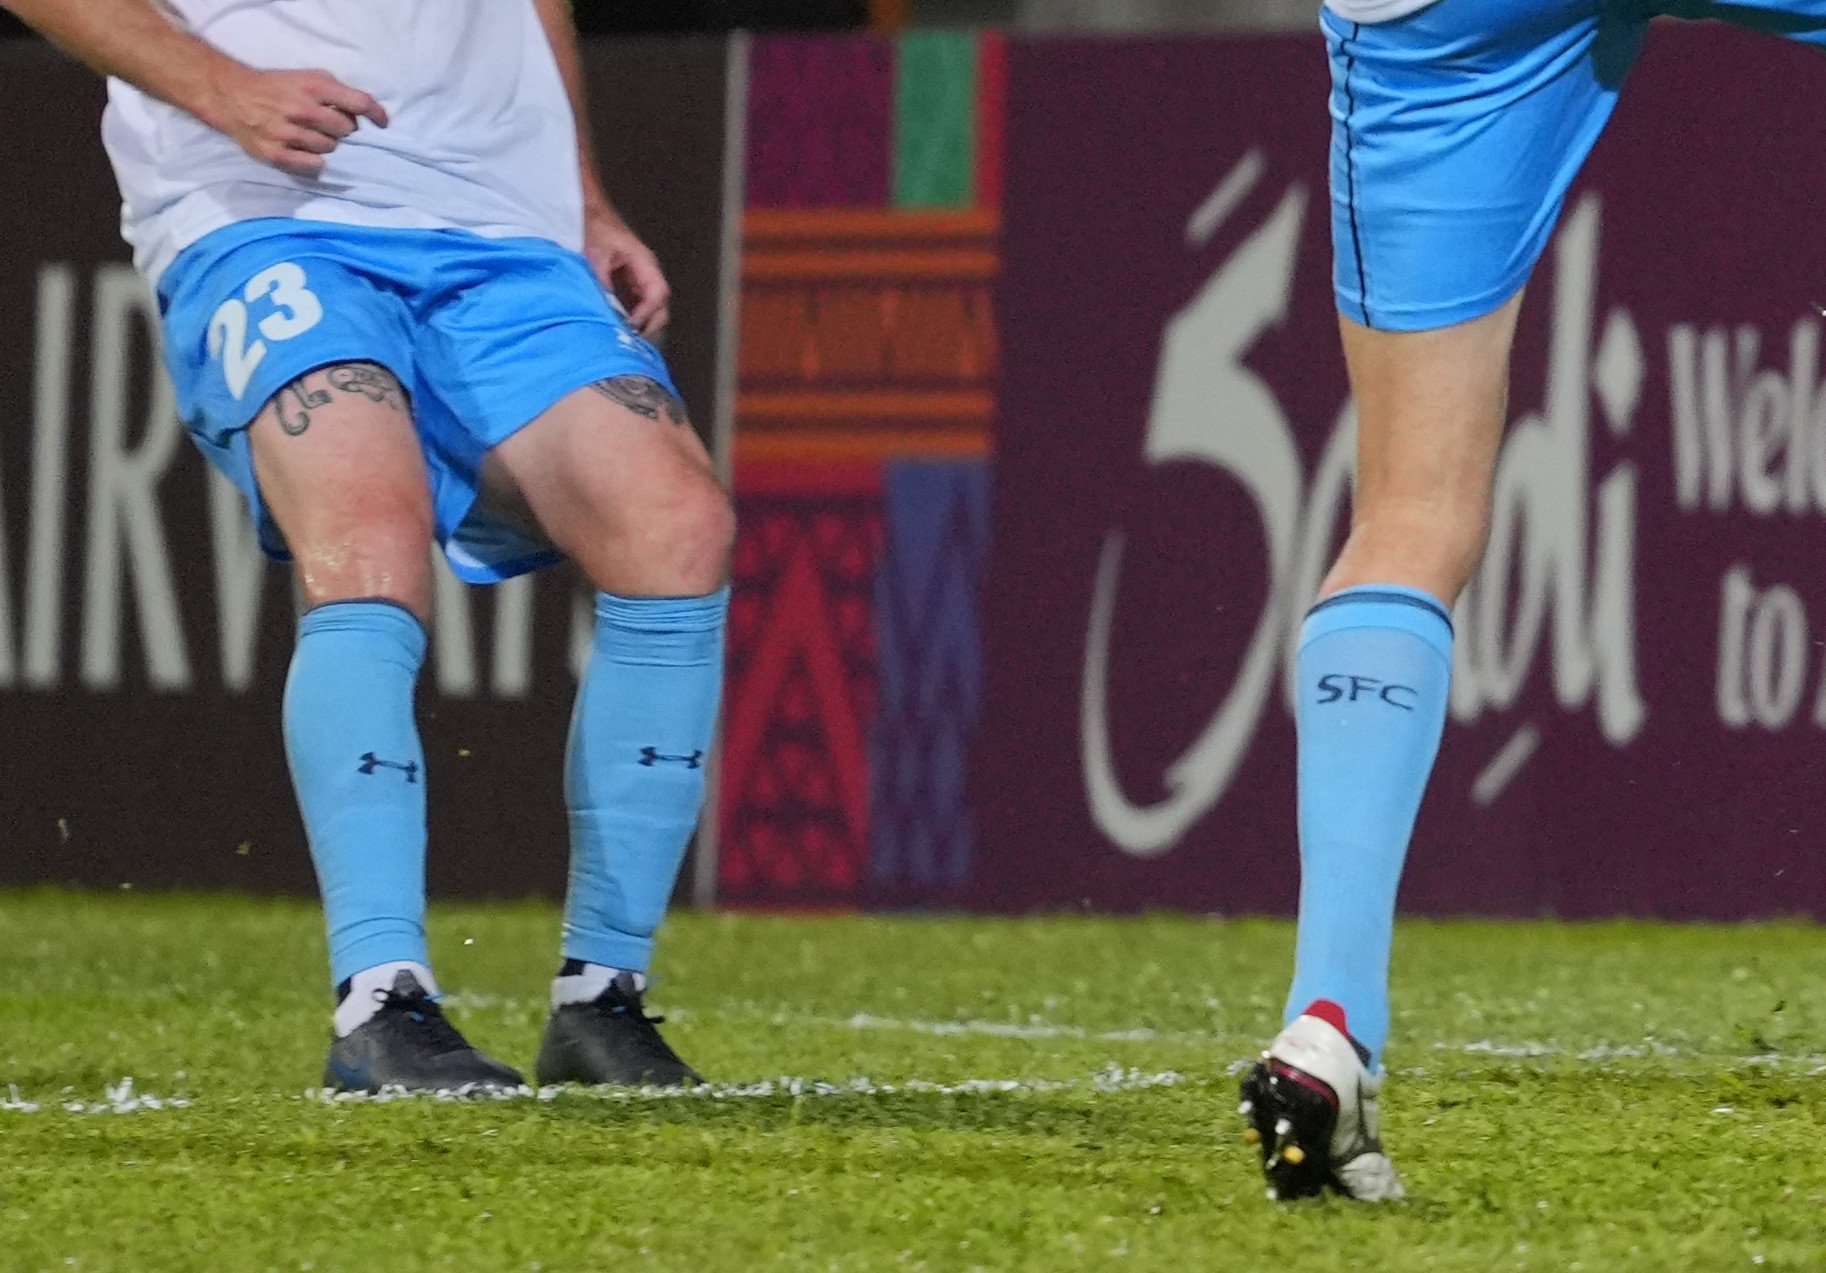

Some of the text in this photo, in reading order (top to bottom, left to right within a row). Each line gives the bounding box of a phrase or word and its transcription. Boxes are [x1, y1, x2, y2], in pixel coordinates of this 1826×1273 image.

[206, 261, 324, 401] 23
[1316, 673, 1419, 712] SFC
[1714, 562, 1807, 729] to
